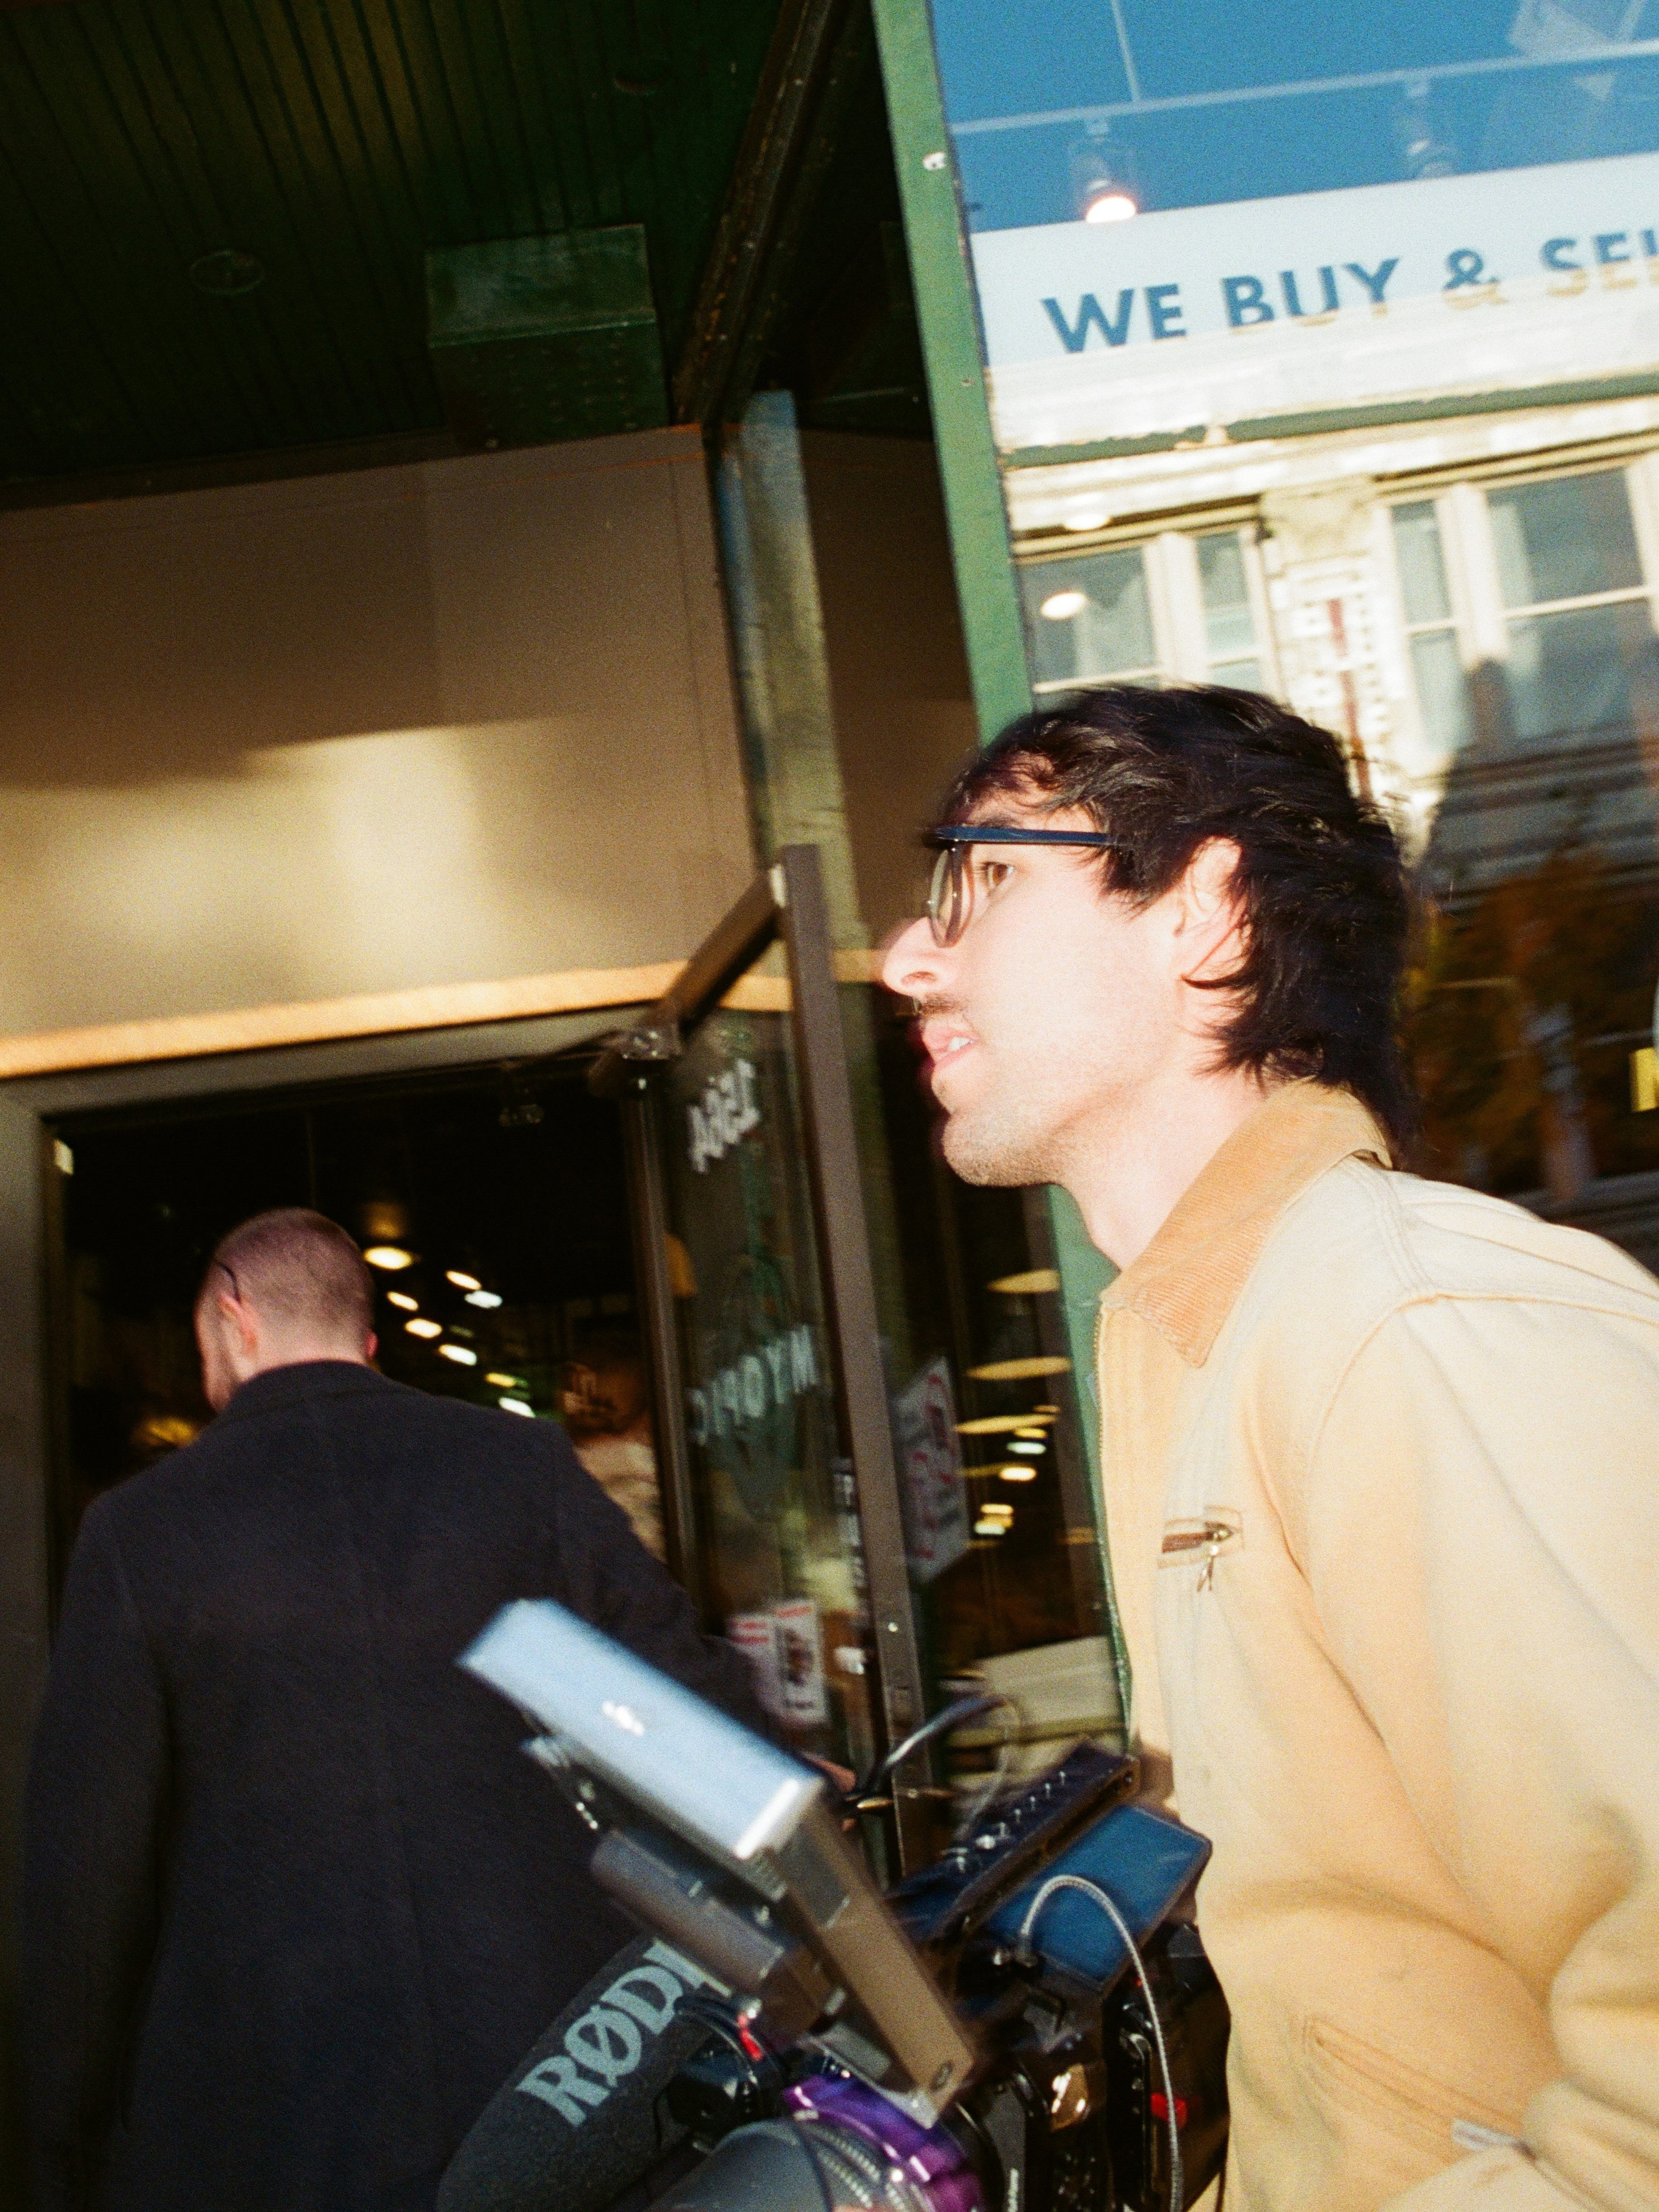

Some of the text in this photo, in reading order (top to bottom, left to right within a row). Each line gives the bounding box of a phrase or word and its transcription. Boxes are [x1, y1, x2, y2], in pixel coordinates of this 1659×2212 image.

[1041, 283, 1187, 355] WE
[1220, 257, 1400, 334] BUY
[1441, 247, 1509, 311] &
